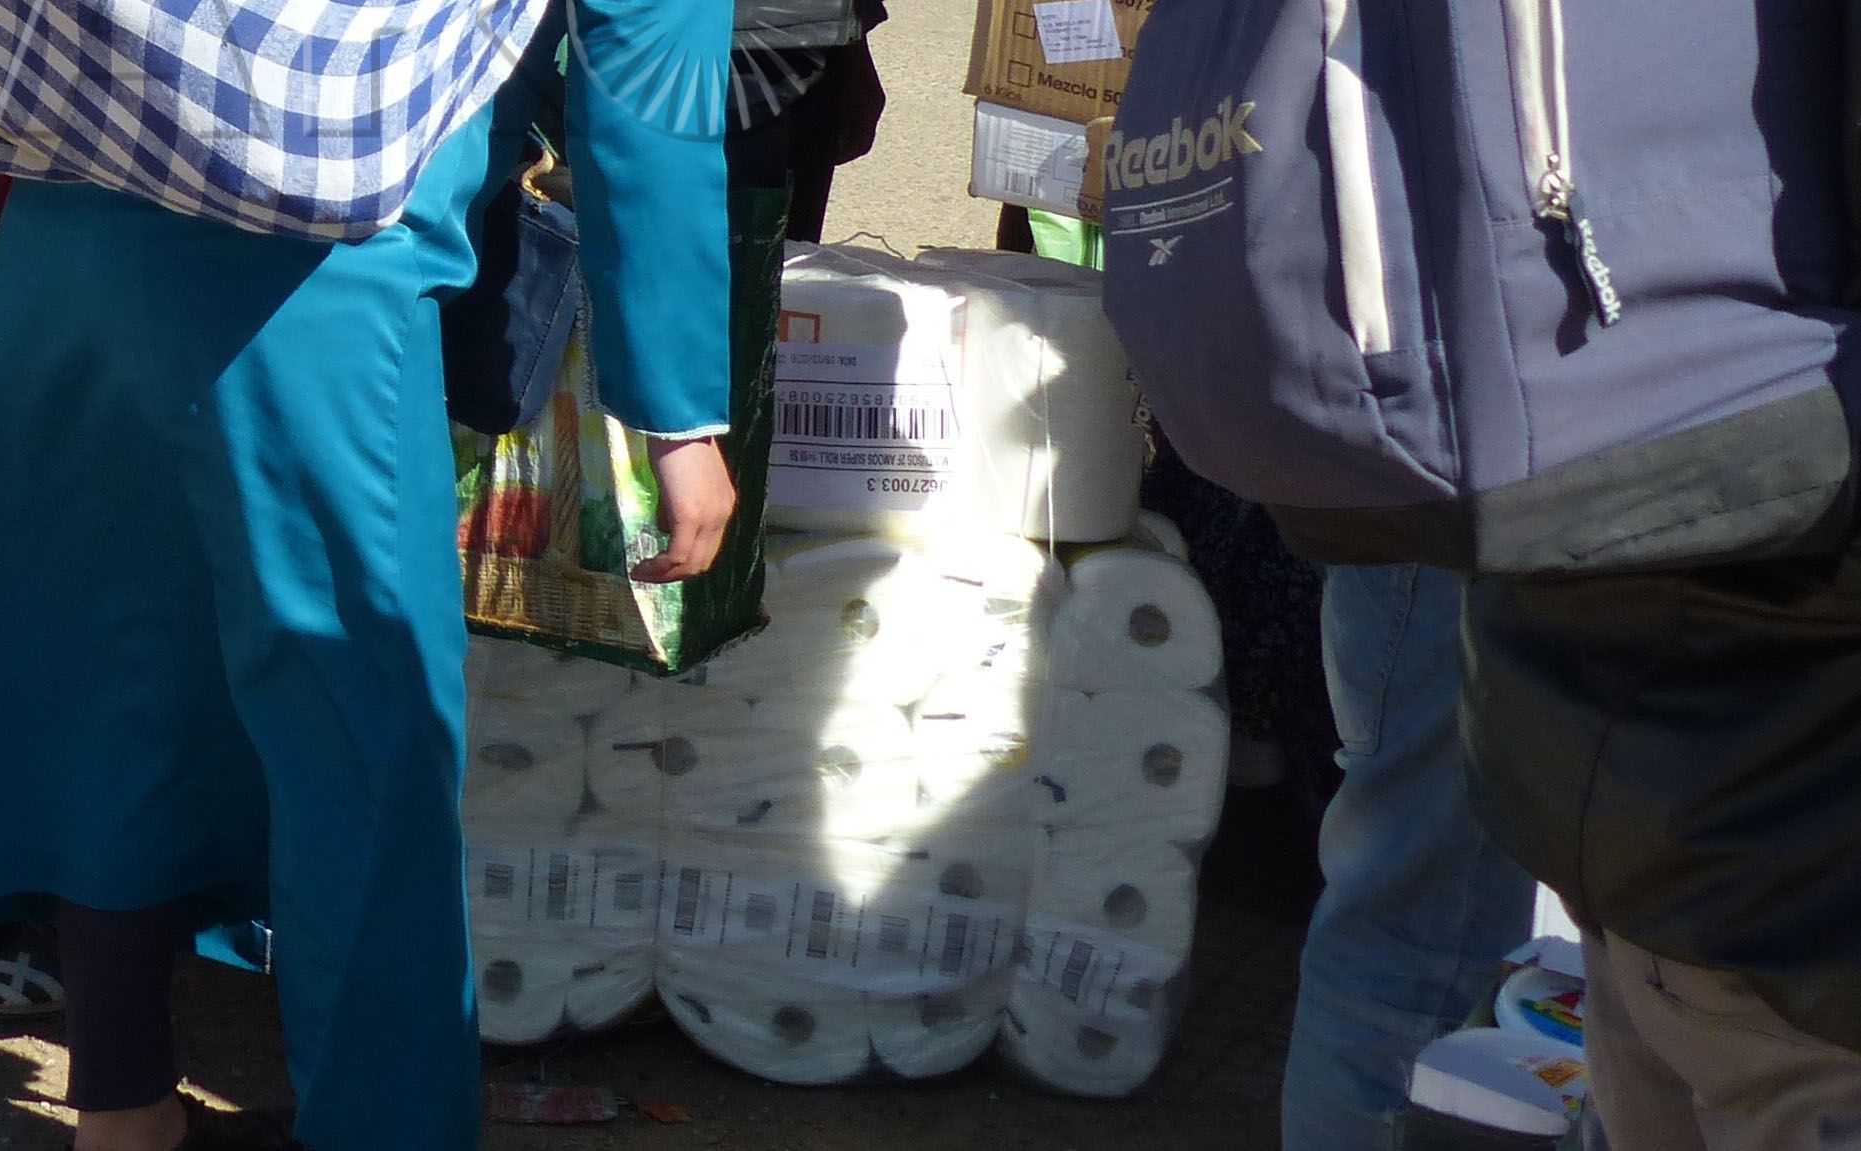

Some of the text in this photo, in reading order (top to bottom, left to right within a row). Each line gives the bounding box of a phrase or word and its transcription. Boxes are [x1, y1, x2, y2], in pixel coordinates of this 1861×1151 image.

[1037, 71, 1098, 99] Mezcla
[1104, 94, 1265, 191] Reebok
[1576, 217, 1623, 326] Reebok
